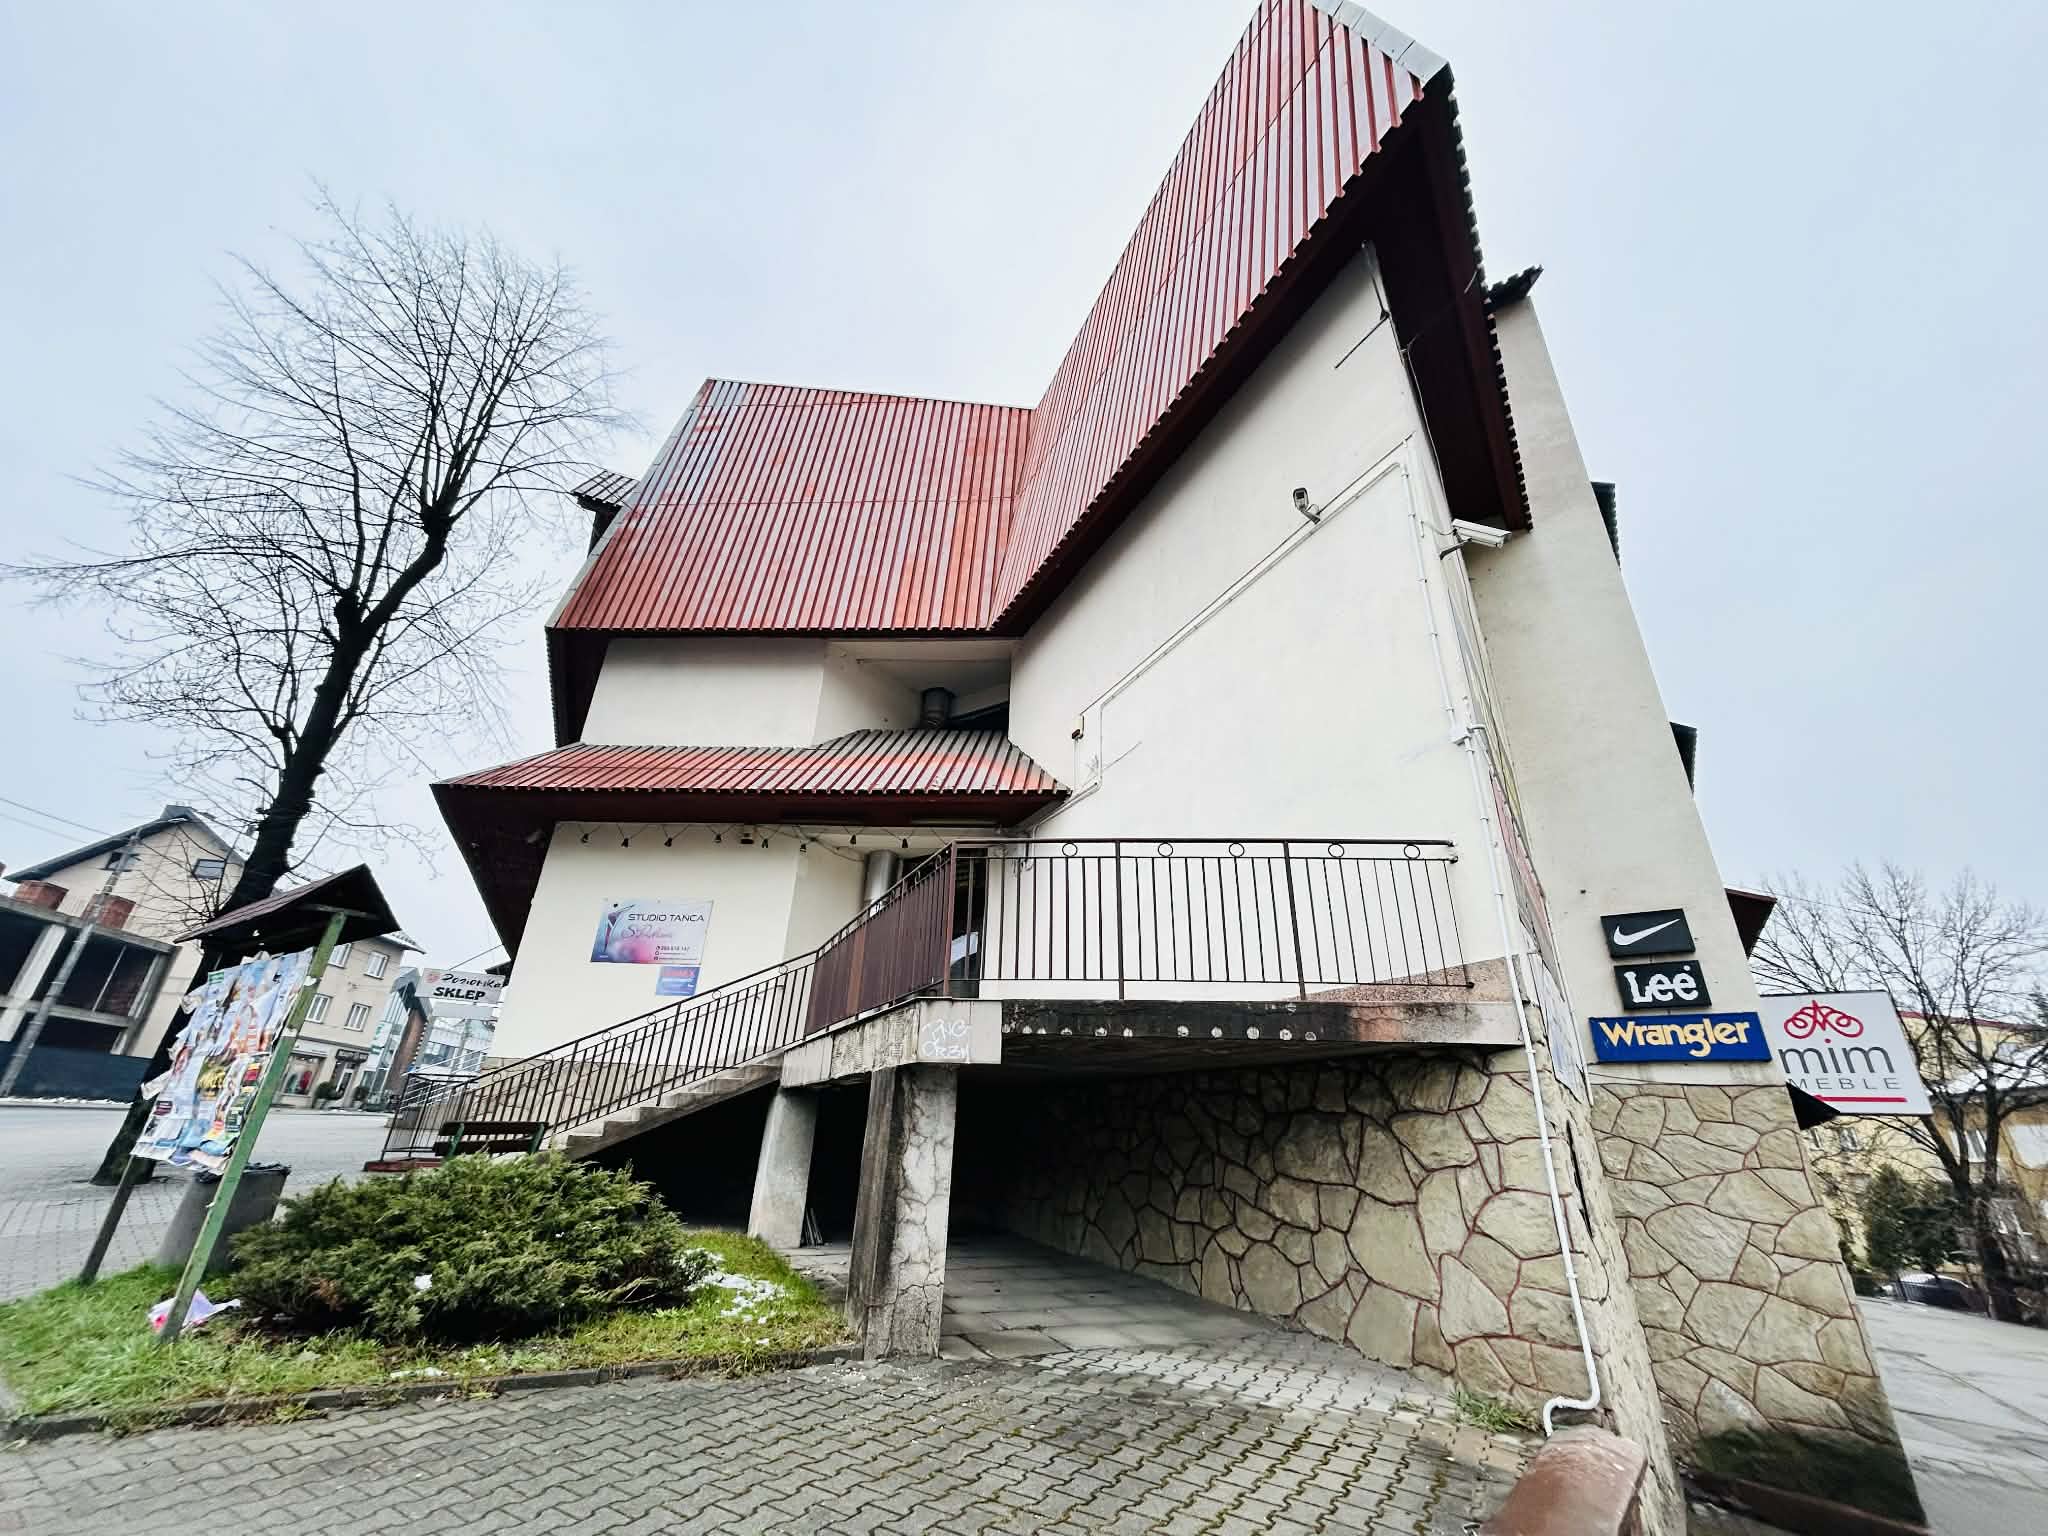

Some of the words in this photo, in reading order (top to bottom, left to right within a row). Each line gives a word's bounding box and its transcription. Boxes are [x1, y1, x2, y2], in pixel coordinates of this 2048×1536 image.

[628, 913, 667, 922] STUDIO
[669, 914, 704, 922] TANCA
[433, 986, 486, 1000] SKLEP
[1624, 971, 1699, 1003] Lee
[1599, 1018, 1750, 1057] Wrangler
[1778, 1038, 1895, 1074] mim
[1787, 1078, 1903, 1090] MEBLE
